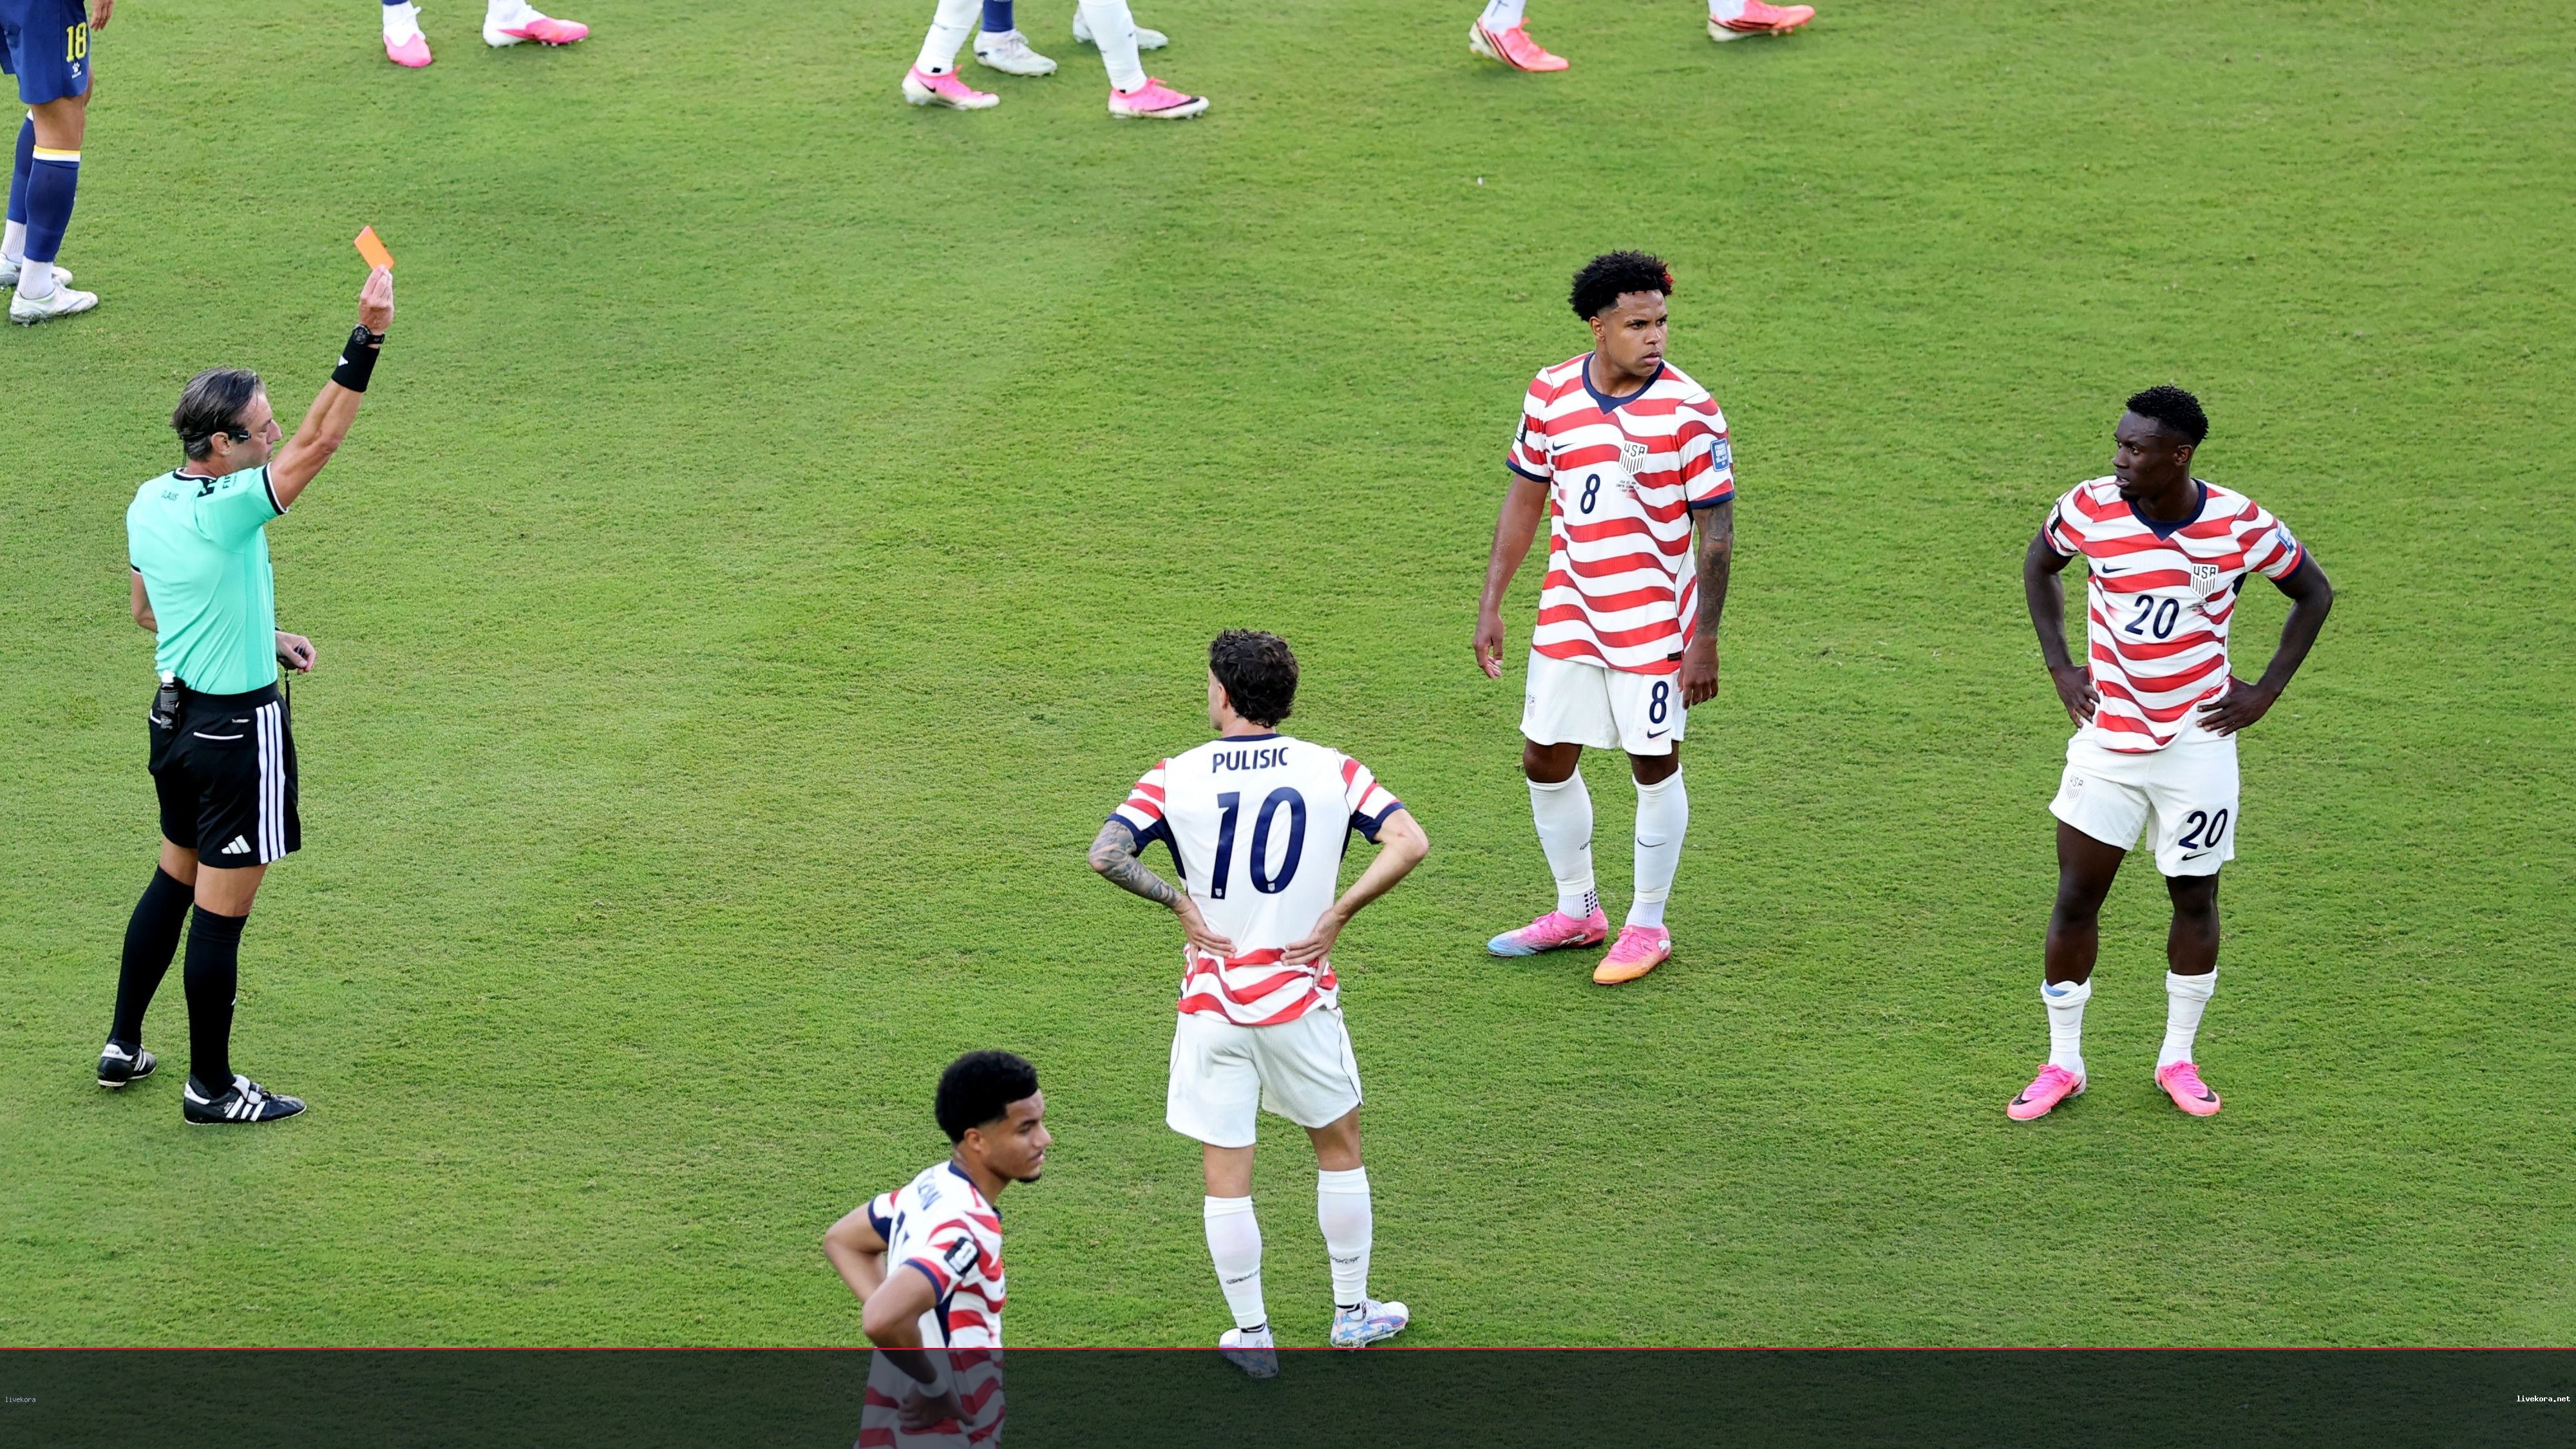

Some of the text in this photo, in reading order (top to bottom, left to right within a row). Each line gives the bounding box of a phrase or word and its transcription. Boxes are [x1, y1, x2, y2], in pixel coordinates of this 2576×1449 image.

[66, 22, 88, 62] 18
[1624, 442, 1645, 457] USA
[1580, 473, 1600, 515] 8
[2193, 565, 2217, 580] USA
[2125, 594, 2179, 639] 20
[1649, 680, 1669, 724] 8
[1212, 746, 1289, 773] PULISIC
[2070, 774, 2084, 787] USA
[1211, 786, 1307, 900] 10
[2177, 808, 2228, 850] 20
